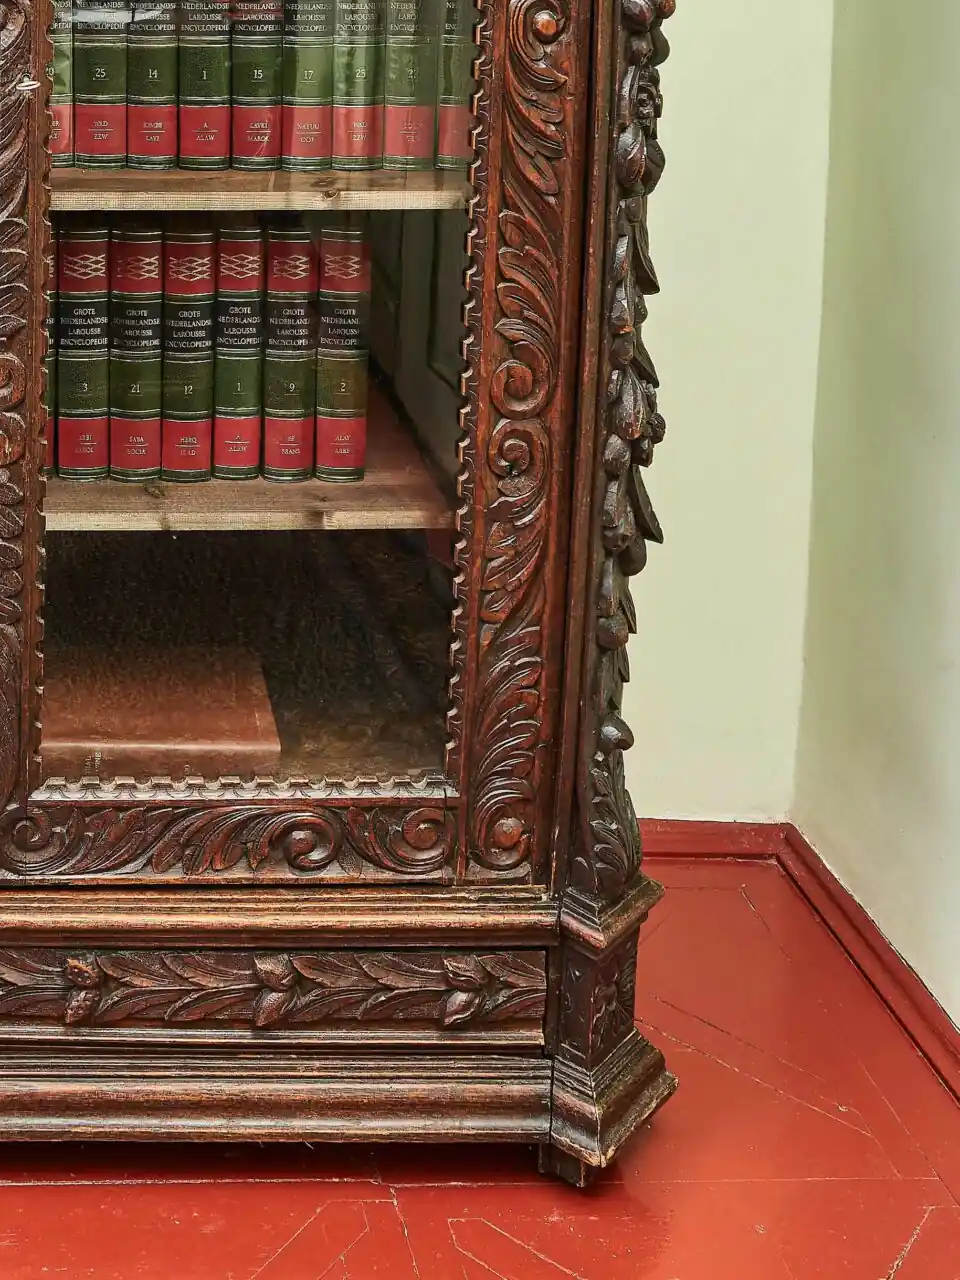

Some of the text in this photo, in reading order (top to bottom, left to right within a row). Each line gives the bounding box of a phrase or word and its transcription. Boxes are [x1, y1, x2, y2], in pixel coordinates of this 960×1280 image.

[95, 68, 106, 78] 25
[148, 68, 158, 78] 14
[253, 69, 263, 79] 15
[304, 70, 314, 79] 17
[356, 69, 365, 78] 25
[74, 308, 96, 316] GROTE
[179, 310, 201, 318] GROTE
[131, 384, 140, 393] 21
[184, 385, 193, 394] 12
